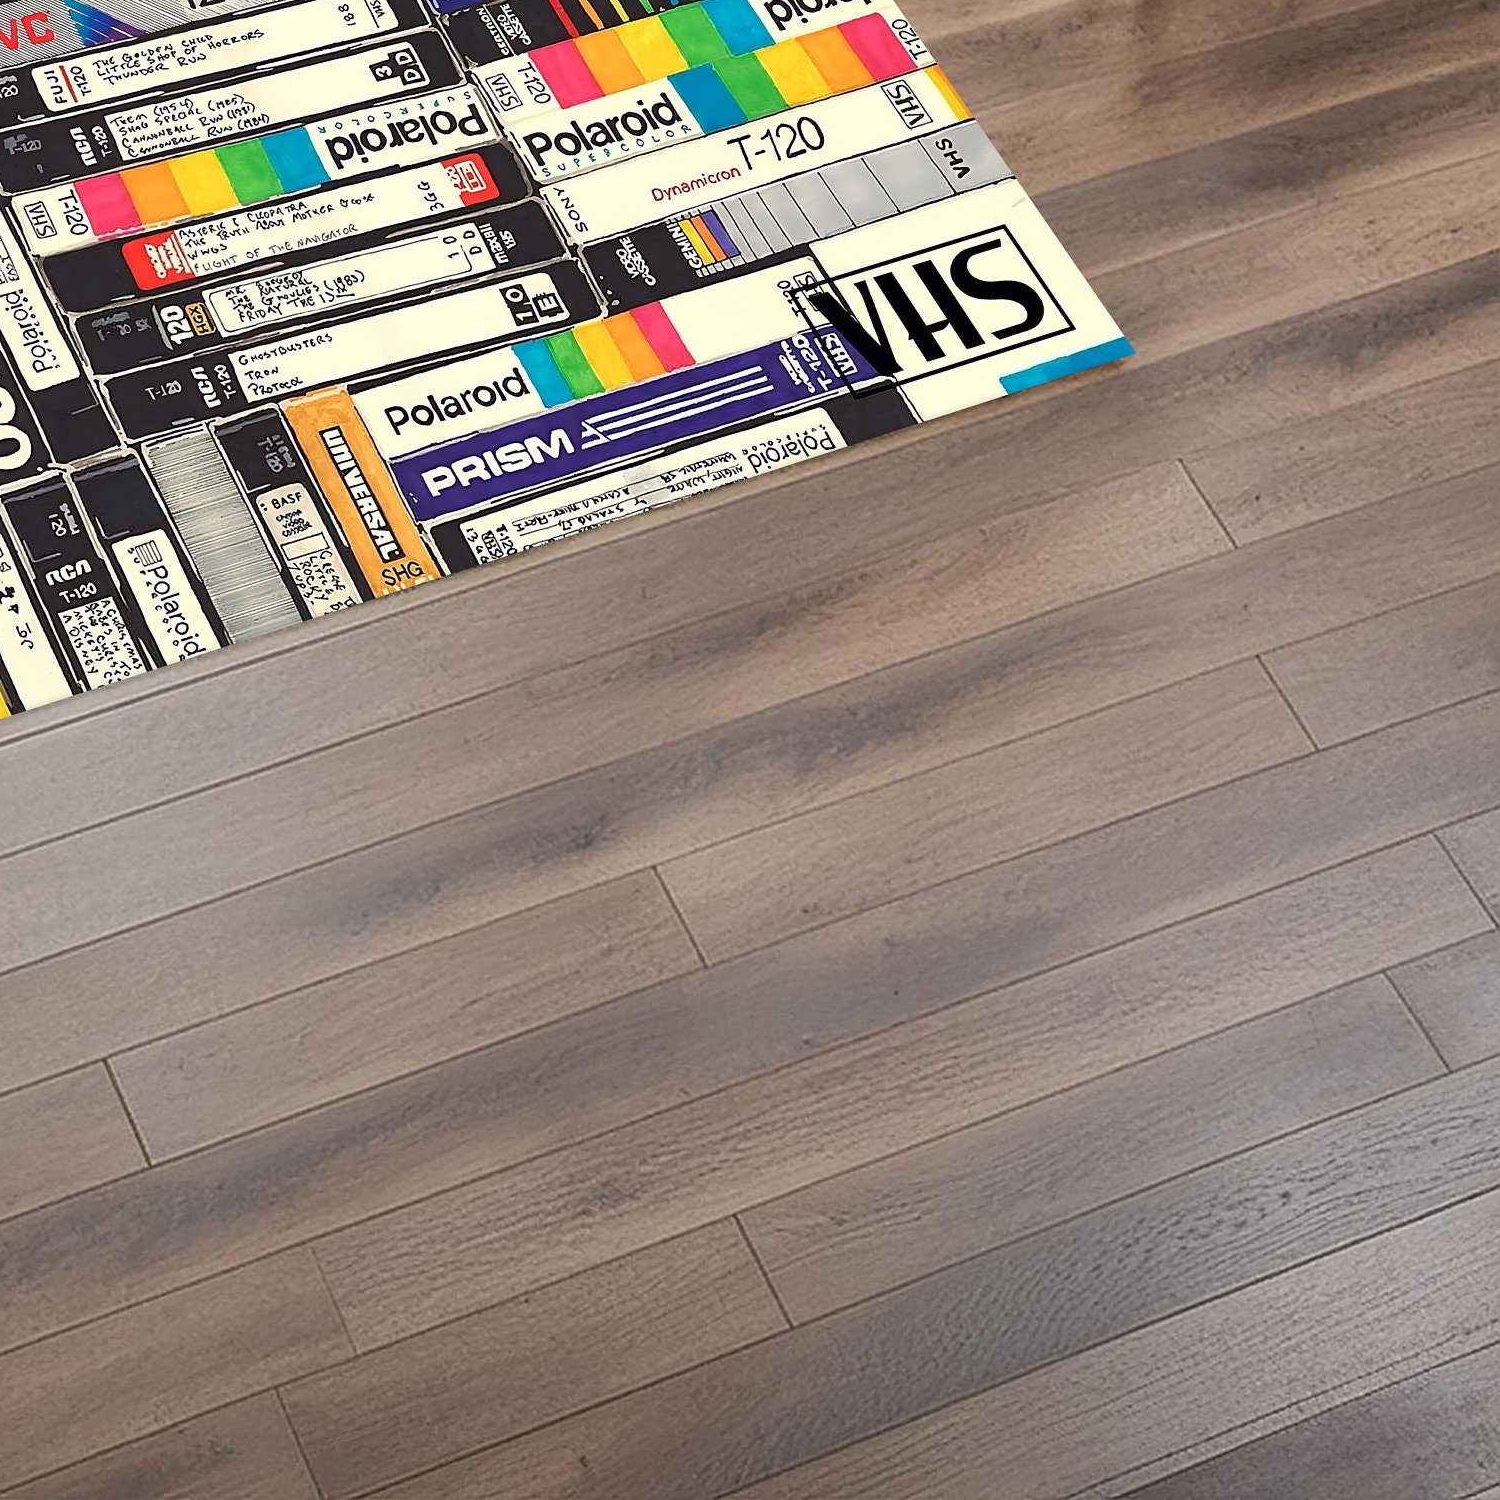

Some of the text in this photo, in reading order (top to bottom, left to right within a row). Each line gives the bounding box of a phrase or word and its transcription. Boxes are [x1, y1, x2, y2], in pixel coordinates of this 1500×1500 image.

[95, 59, 141, 77] LITTLE
[206, 28, 265, 50] HORRORS
[175, 52, 207, 67] RUN
[890, 17, 928, 61] T-120
[69, 65, 92, 97] T-120
[91, 56, 119, 71] THE
[516, 61, 551, 104] T-120
[42, 69, 68, 104] FUJI
[486, 74, 521, 110] VHS
[885, 81, 925, 126] VHS
[324, 102, 488, 169] Polaroid
[522, 91, 682, 166] Polaroid
[726, 116, 825, 170] T-120
[540, 123, 692, 177] SUPERCOLOR
[934, 137, 971, 179] VHS
[650, 166, 742, 202] Dynamicron
[24, 201, 56, 239] VHS
[57, 189, 89, 236] T-120
[552, 186, 589, 233] SONY
[245, 246, 260, 259] OF
[267, 240, 294, 254] THE
[296, 222, 359, 249] NAVIGATOR
[0, 289, 53, 373] Polaroid
[155, 304, 194, 345] 120
[187, 305, 210, 334] HGX
[808, 239, 1043, 381] VHS
[237, 332, 333, 366] GHOSTBUSTERS
[189, 365, 221, 408] RCA
[213, 363, 237, 400] T-120
[243, 365, 279, 380] TRON
[383, 366, 530, 435] Polaroid
[421, 428, 574, 496] PRISM
[744, 426, 836, 474] Polaroid
[270, 490, 302, 510] BASF
[322, 428, 399, 560] UNIVERSAL
[44, 558, 92, 586] RCA
[58, 581, 97, 603] T-120
[380, 560, 424, 587] SHG
[146, 564, 206, 657] Polaroid
